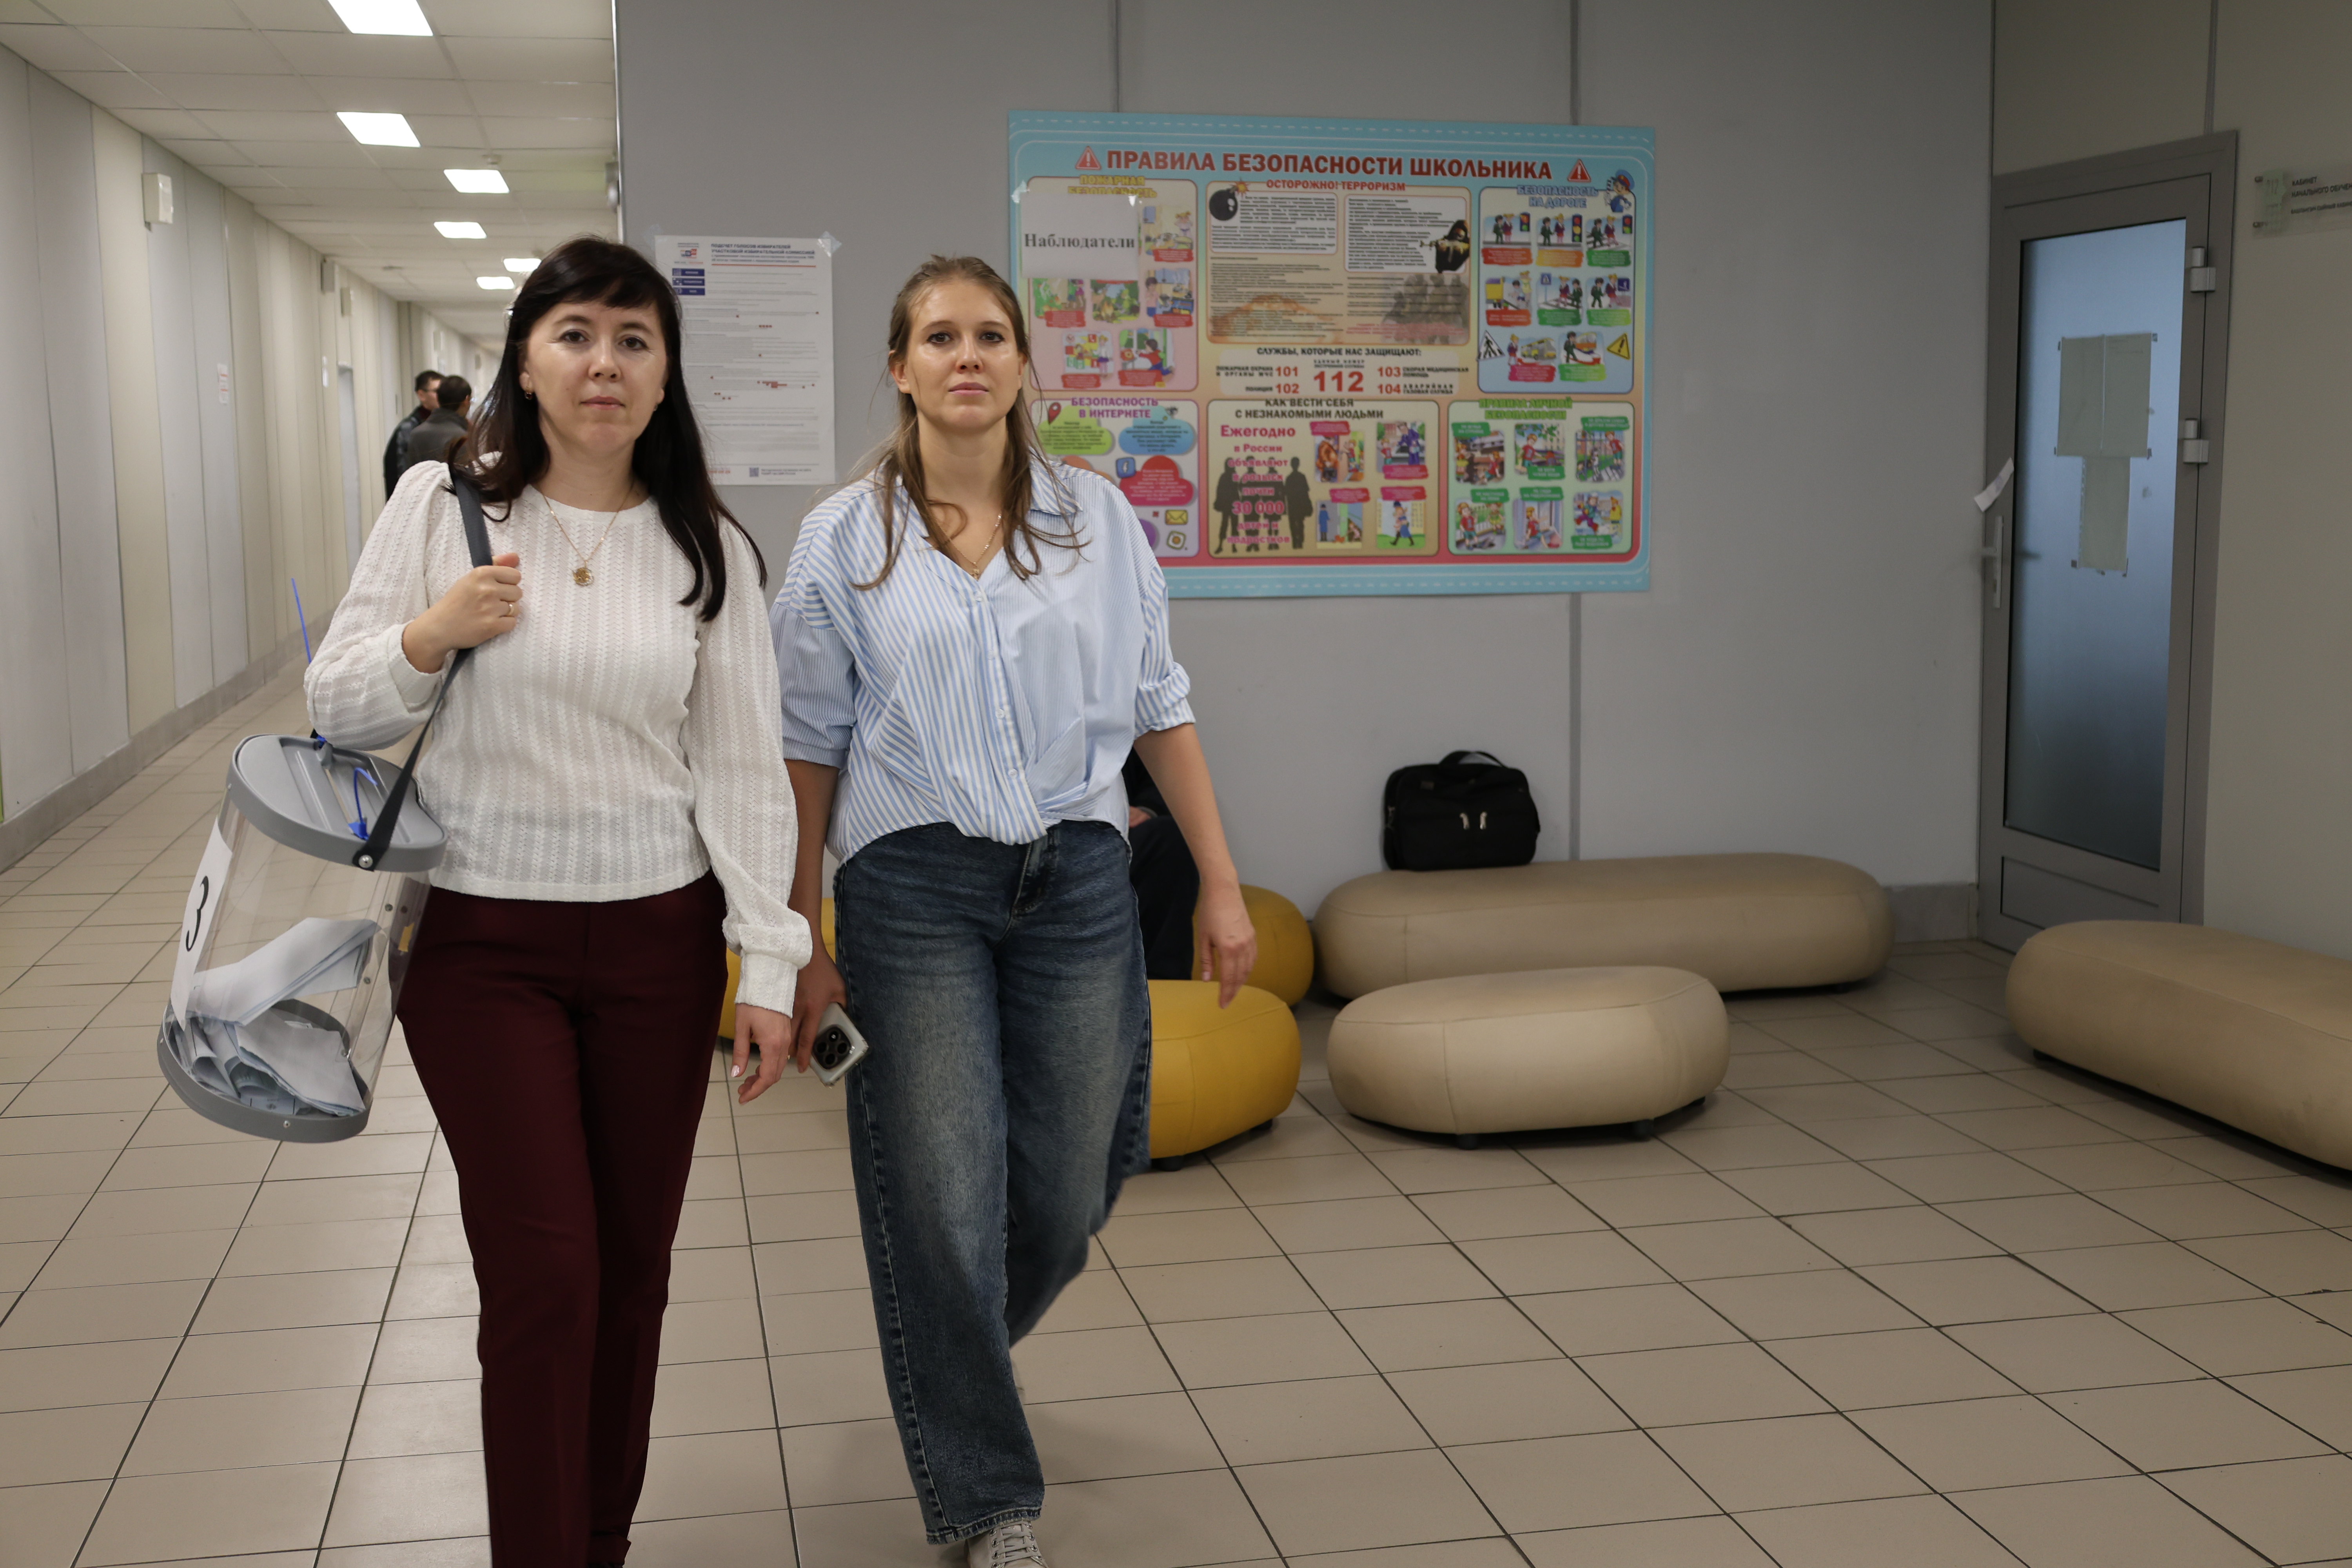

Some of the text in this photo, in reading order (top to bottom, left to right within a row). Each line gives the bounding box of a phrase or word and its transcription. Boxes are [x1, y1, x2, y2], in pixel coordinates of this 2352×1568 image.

[1107, 151, 1552, 179] ПРАВИЛА БЕЗОПАСНОСТИ ШКОЛЬНИКА
[1080, 175, 1145, 186] ПОЖАРНАЯ
[1266, 179, 1405, 191] ОСТОРОЖНО! ТЕРРОРИЗМ
[2292, 176, 2317, 185] КАБИНЕТ
[1068, 186, 1158, 198] БЕЗОПАСНОСТЬ
[1517, 185, 1598, 196] БЕЗОПАСНОСТЬ
[1530, 198, 1587, 208] НА ДОРОГЕ
[1024, 234, 1134, 249] Наблюдатели
[1257, 347, 1299, 356] СЛУЖБЫ,
[1301, 348, 1343, 356] КОТОРЫЕ
[1275, 366, 1298, 377] 101
[1377, 366, 1401, 377] 103
[1313, 370, 1365, 392] 112
[1275, 383, 1299, 394] 102
[1377, 383, 1401, 394] 104
[1071, 397, 1158, 407] БЕЗОПАСНОСТЬ
[1265, 398, 1354, 407] КАК ВЕСТИ СЕБЯ
[1479, 399, 1527, 408] ПРАВИЛА
[1079, 409, 1151, 419] В ИНТЕРНЕТЕ
[1235, 410, 1384, 419] С НЕЗНАКОМЫМИ ЛЮДЬМИ
[1220, 425, 1296, 439] Ежегодно
[1243, 444, 1282, 452] России
[1232, 501, 1285, 515] 30 000
[185, 875, 209, 952] 3
